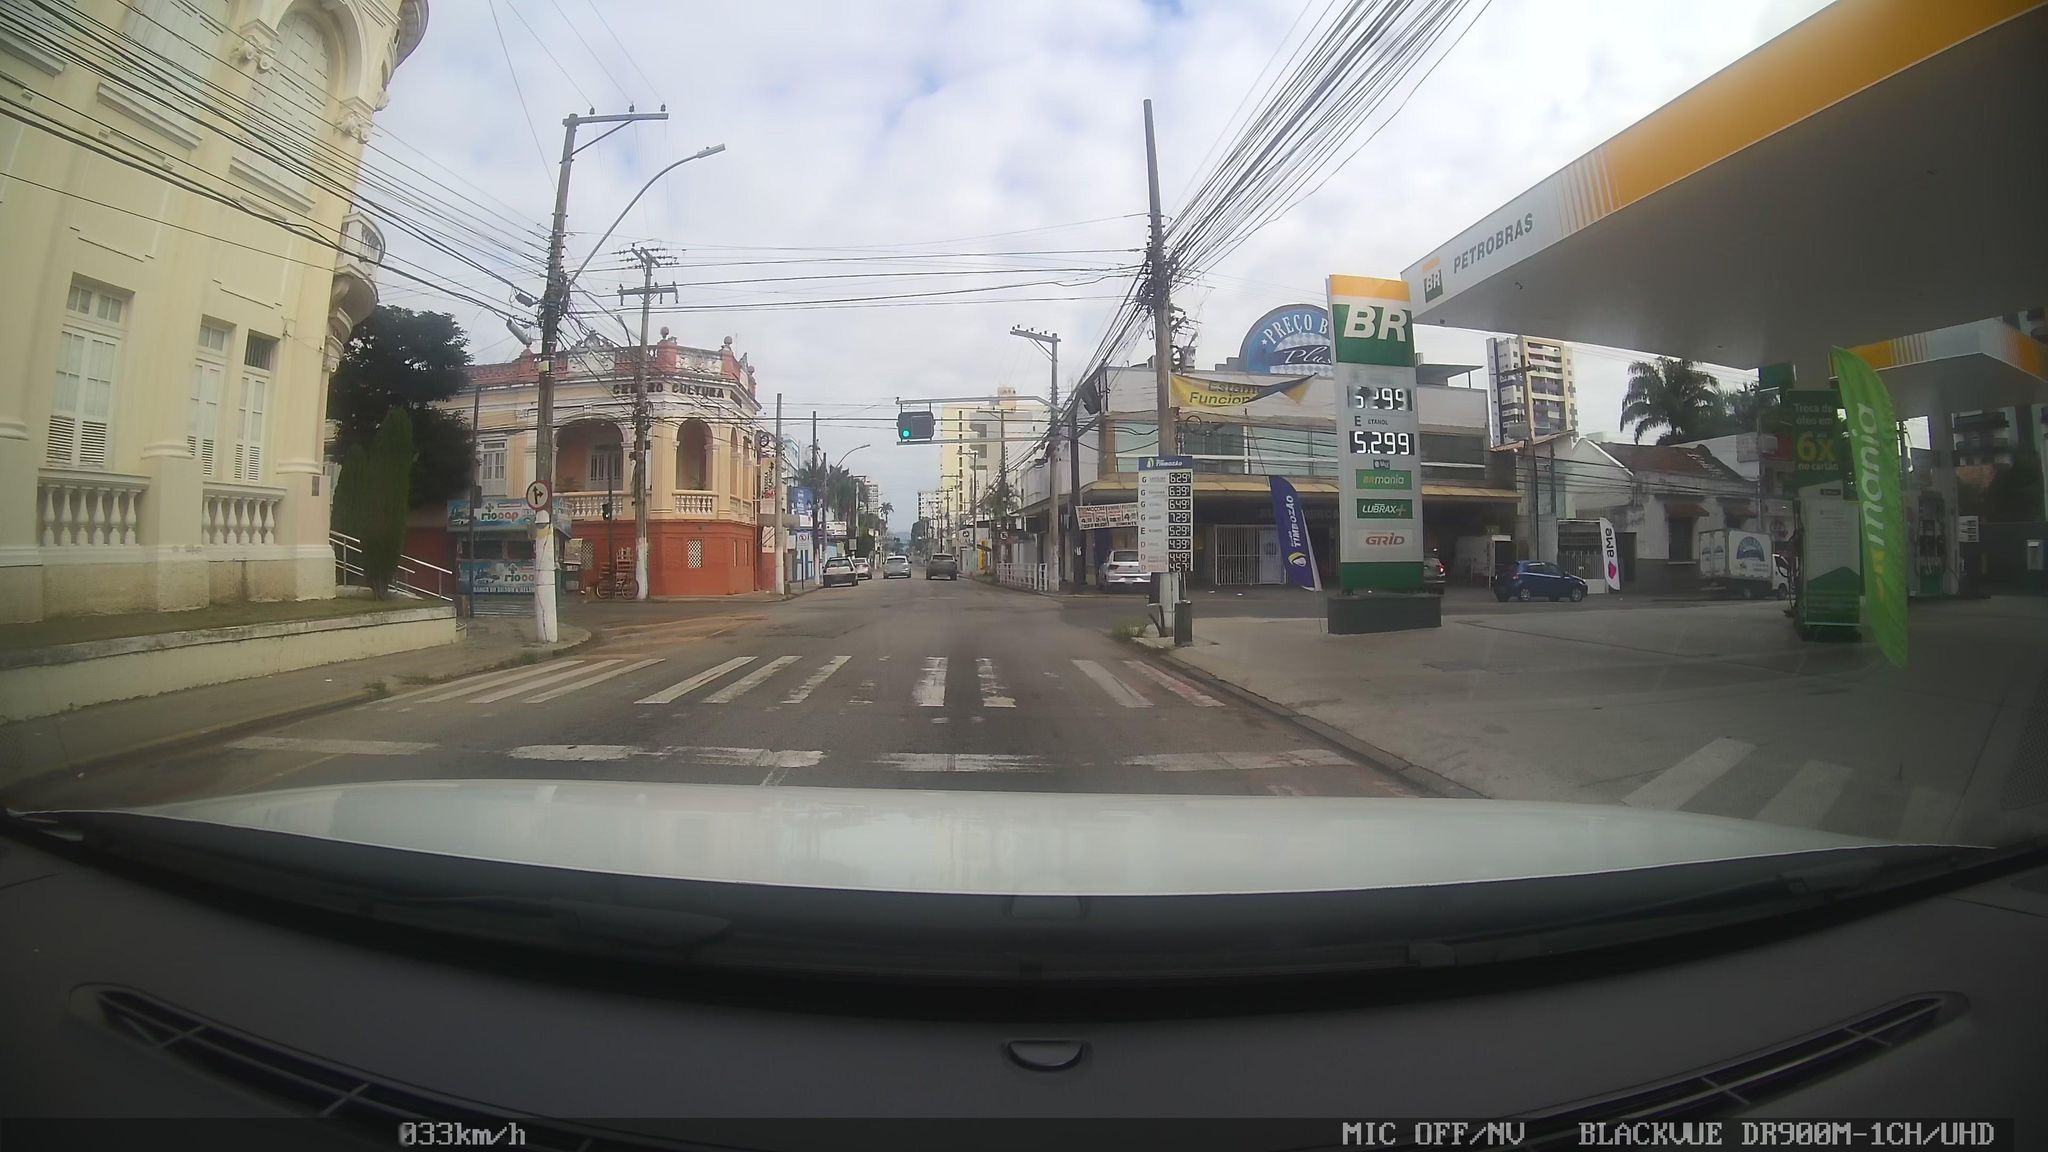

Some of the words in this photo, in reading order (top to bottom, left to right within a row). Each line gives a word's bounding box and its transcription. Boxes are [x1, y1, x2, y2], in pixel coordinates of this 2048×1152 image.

[1453, 213, 1533, 274] PETROBRAS
[1424, 270, 1441, 293] BR
[1264, 314, 1313, 345] PREÇO
[1343, 303, 1407, 342] BR
[1354, 415, 1361, 427] E
[1794, 403, 1818, 413] Troca
